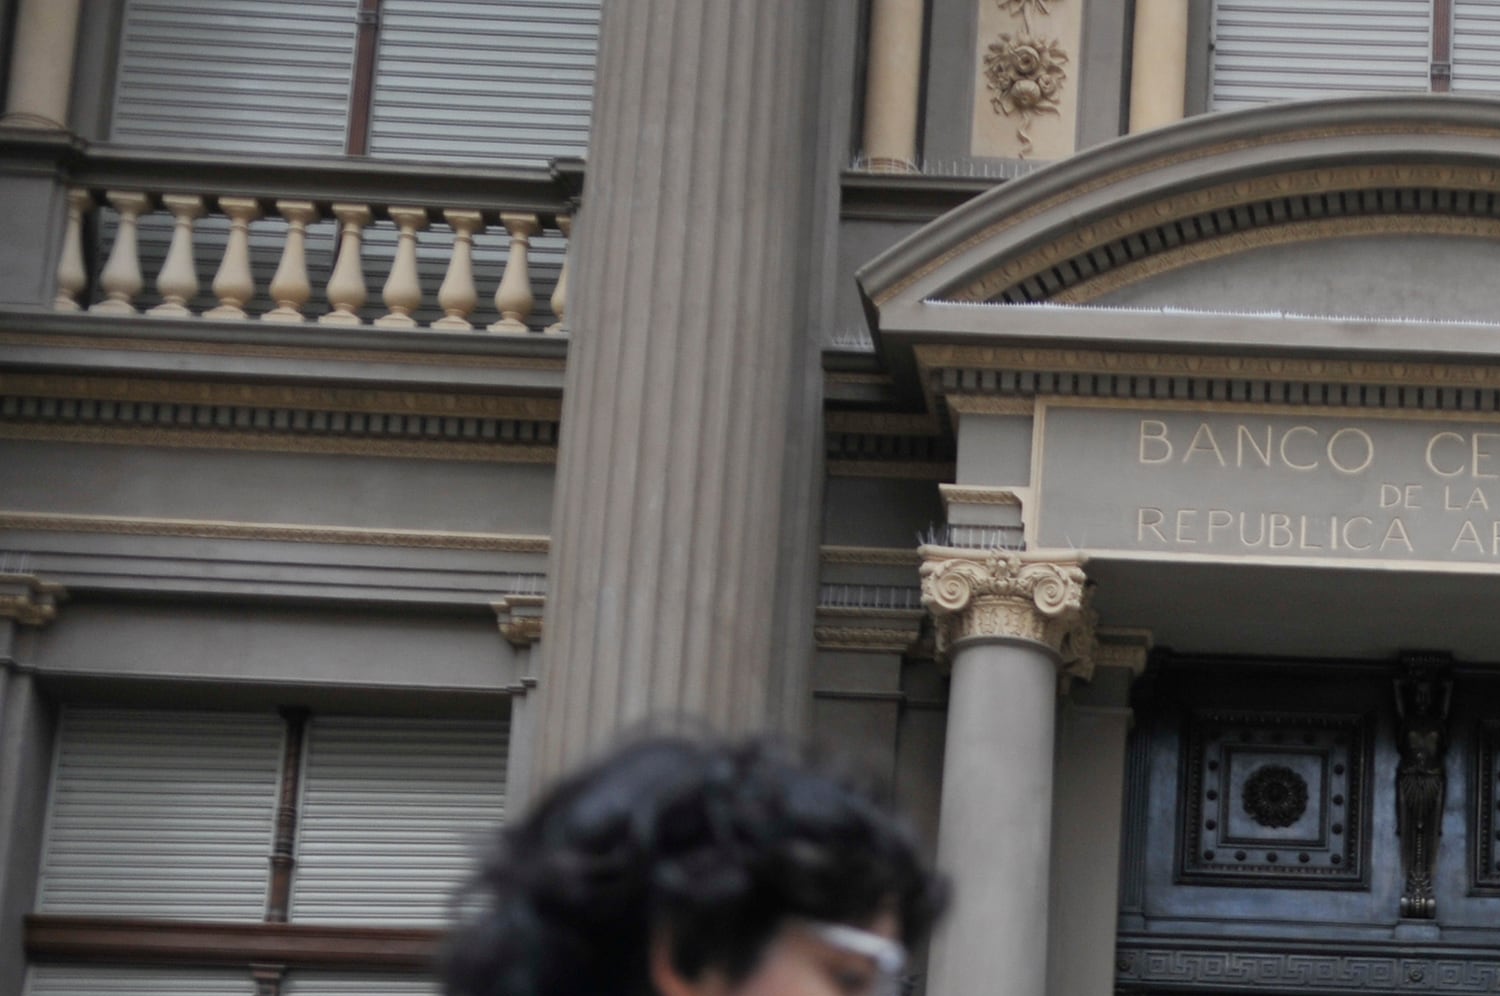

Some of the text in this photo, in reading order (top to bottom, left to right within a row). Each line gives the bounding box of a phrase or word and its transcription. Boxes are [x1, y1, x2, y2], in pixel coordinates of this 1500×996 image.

[1138, 419, 1374, 474] BANCO
[1379, 483, 1490, 512] DE LA
[1137, 507, 1413, 552] REPUBLICA
